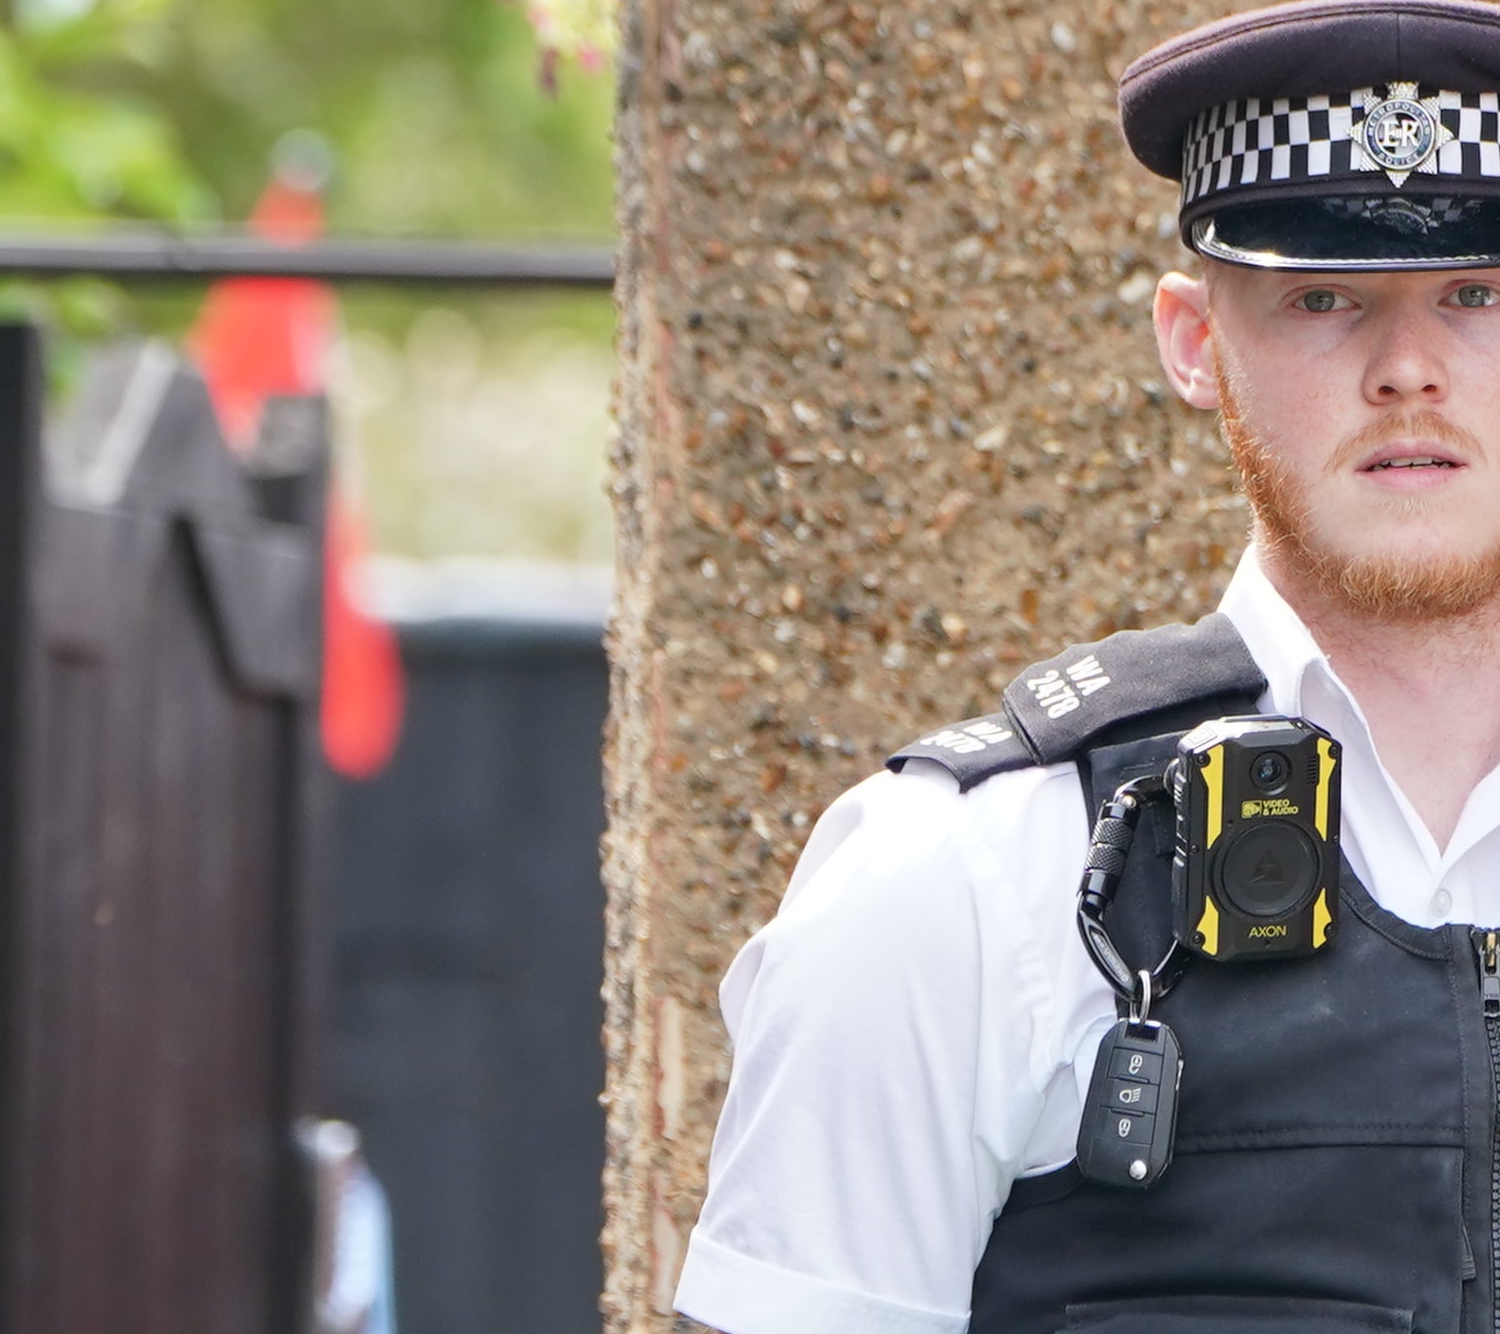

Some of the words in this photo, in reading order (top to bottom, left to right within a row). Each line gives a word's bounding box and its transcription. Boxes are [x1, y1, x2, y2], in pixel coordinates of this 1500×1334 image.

[1379, 118, 1420, 147] ER
[1066, 655, 1111, 696] WA
[1026, 670, 1080, 719] 2478
[1263, 798, 1290, 808] VIDEO
[1271, 806, 1299, 816] AUDIO
[1248, 925, 1287, 938] AXON
